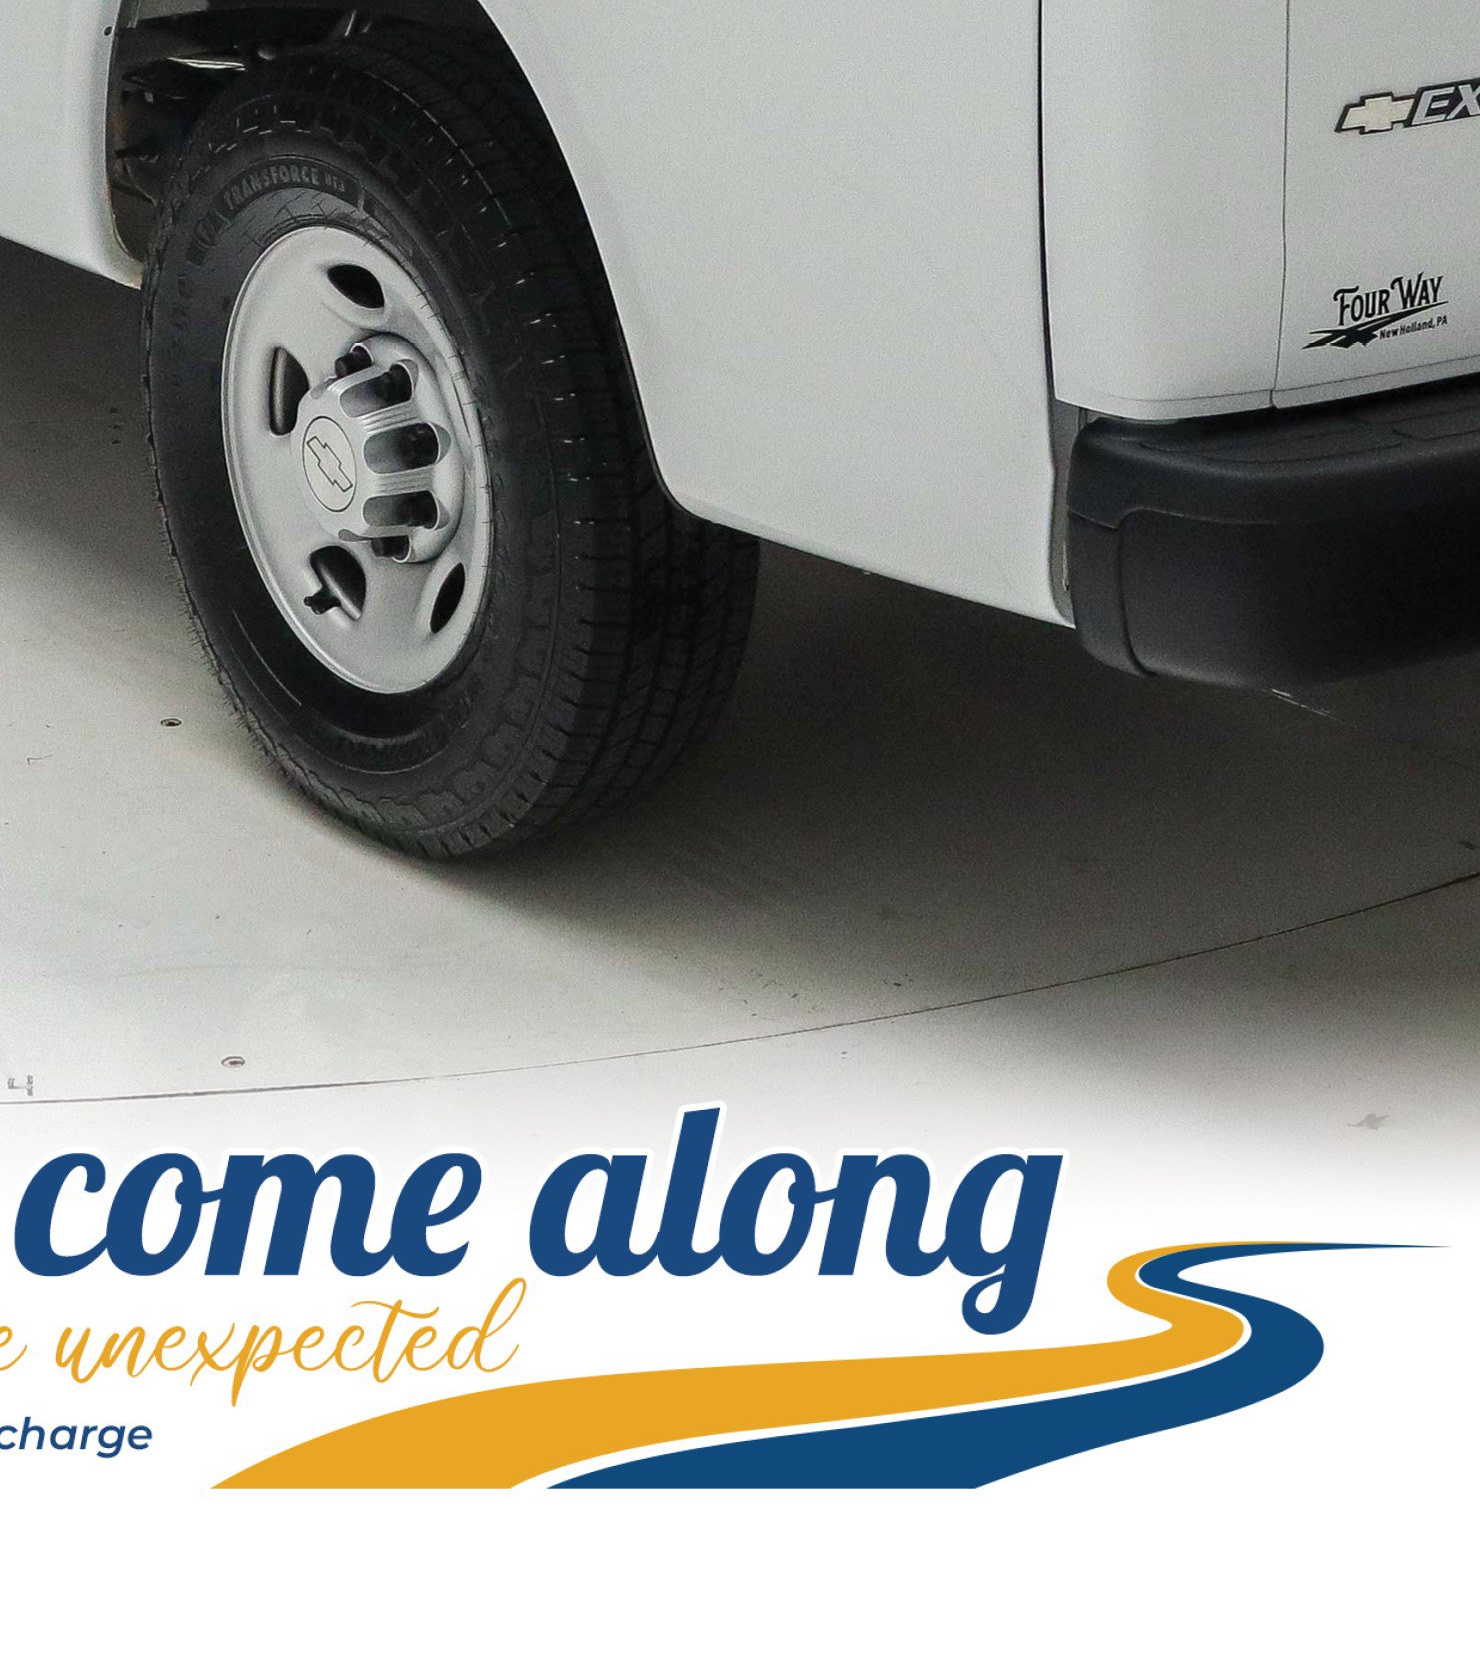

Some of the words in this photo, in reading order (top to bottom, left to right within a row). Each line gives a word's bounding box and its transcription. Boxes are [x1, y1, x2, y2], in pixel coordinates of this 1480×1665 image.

[222, 164, 318, 211] TRANSFORCE
[1333, 285, 1390, 326] FOUR
[1390, 271, 1444, 309] WAY
[1379, 327, 1400, 340] New
[1400, 317, 1435, 333] Holland,
[1436, 315, 1448, 327] PA
